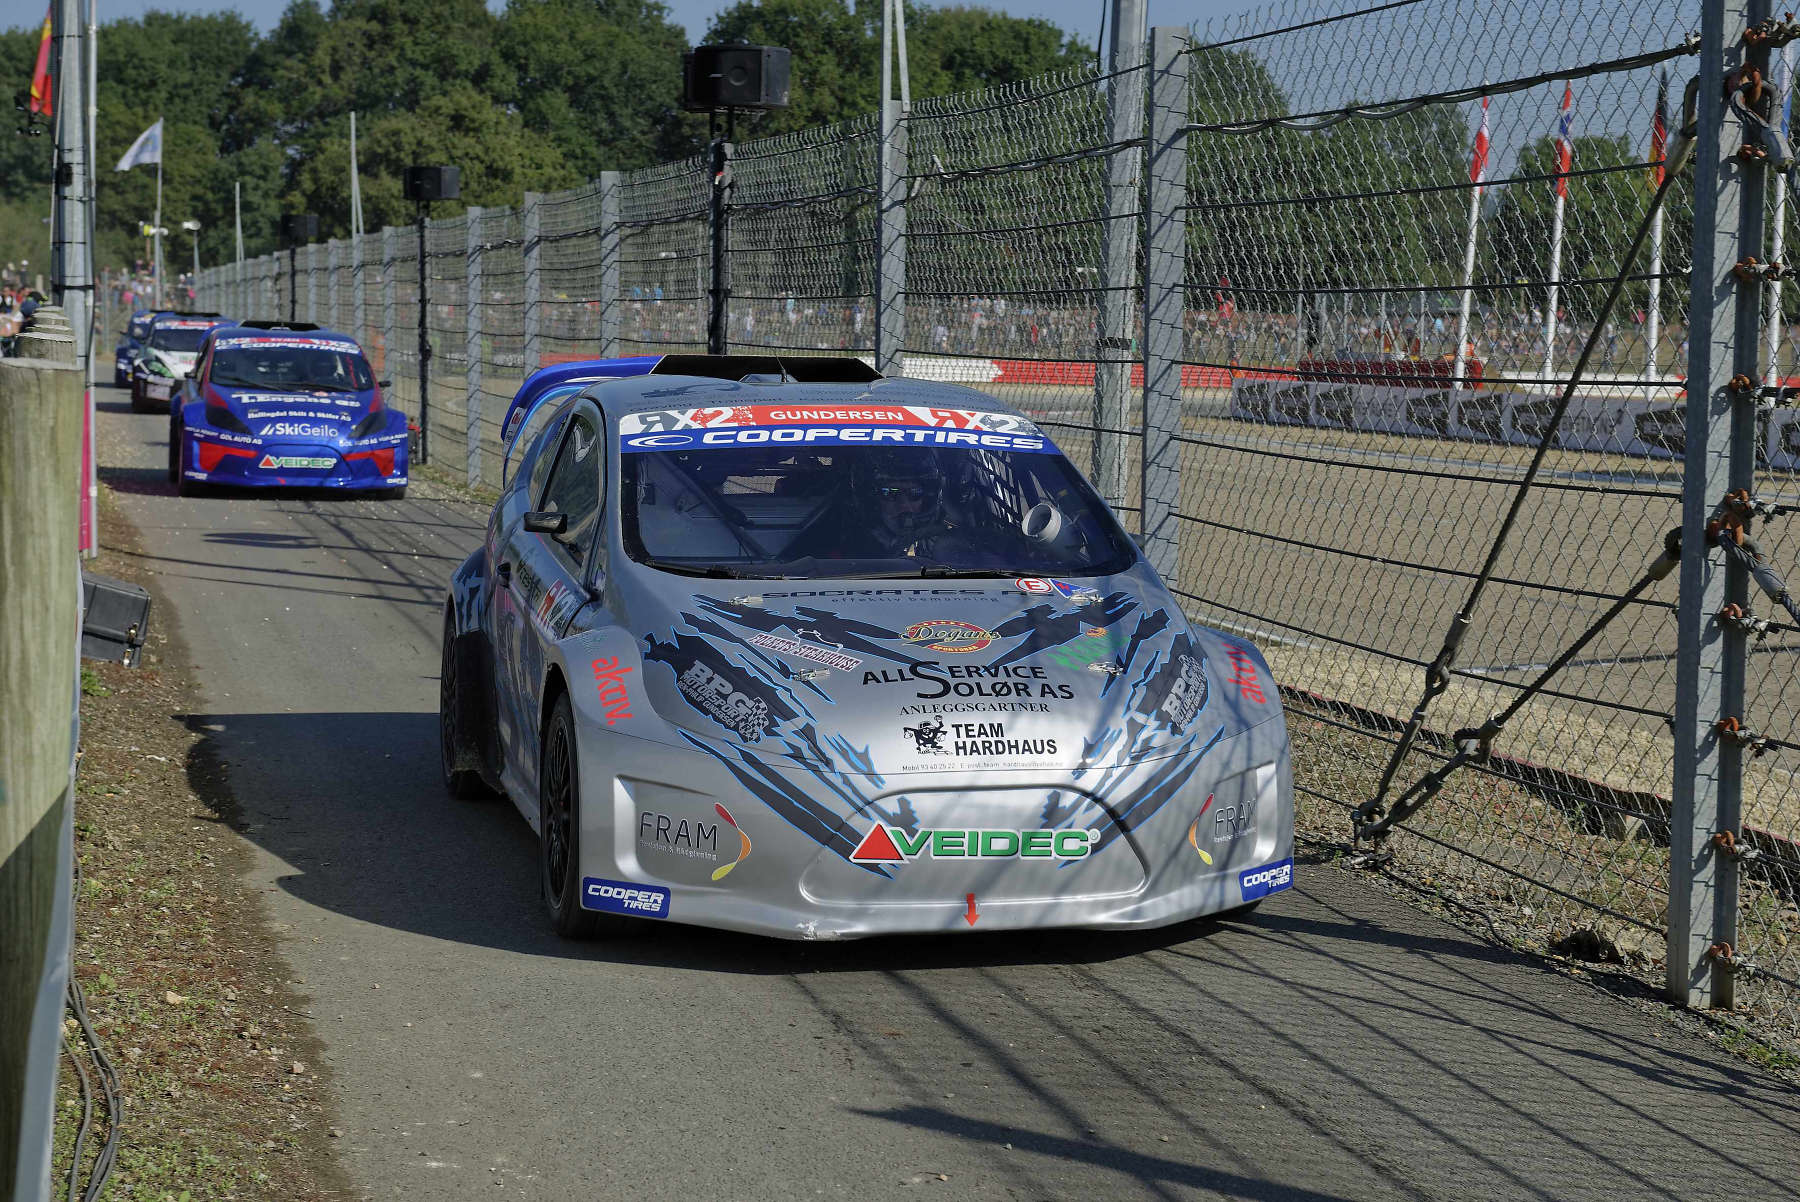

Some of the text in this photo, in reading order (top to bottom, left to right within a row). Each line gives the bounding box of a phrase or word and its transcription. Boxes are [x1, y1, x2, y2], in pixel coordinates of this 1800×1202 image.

[769, 410, 904, 421] GUNDERSEN
[762, 589, 984, 599] SOCRATES
[1023, 580, 1043, 591] E
[793, 644, 862, 672] STEAKHOUSE
[680, 670, 747, 722] MOTORSPORT
[689, 659, 757, 716] BPG
[1039, 683, 1075, 700] AS
[900, 702, 1051, 716] ANLEGGSGARTNER
[951, 723, 1005, 739] TEAM
[955, 739, 1058, 757] HARDHAUS
[640, 810, 719, 851] FRAM
[1243, 864, 1292, 888] COOPER
[1267, 874, 1291, 889] TIRES
[587, 884, 665, 905] COOPER
[623, 899, 662, 912] TIRES
